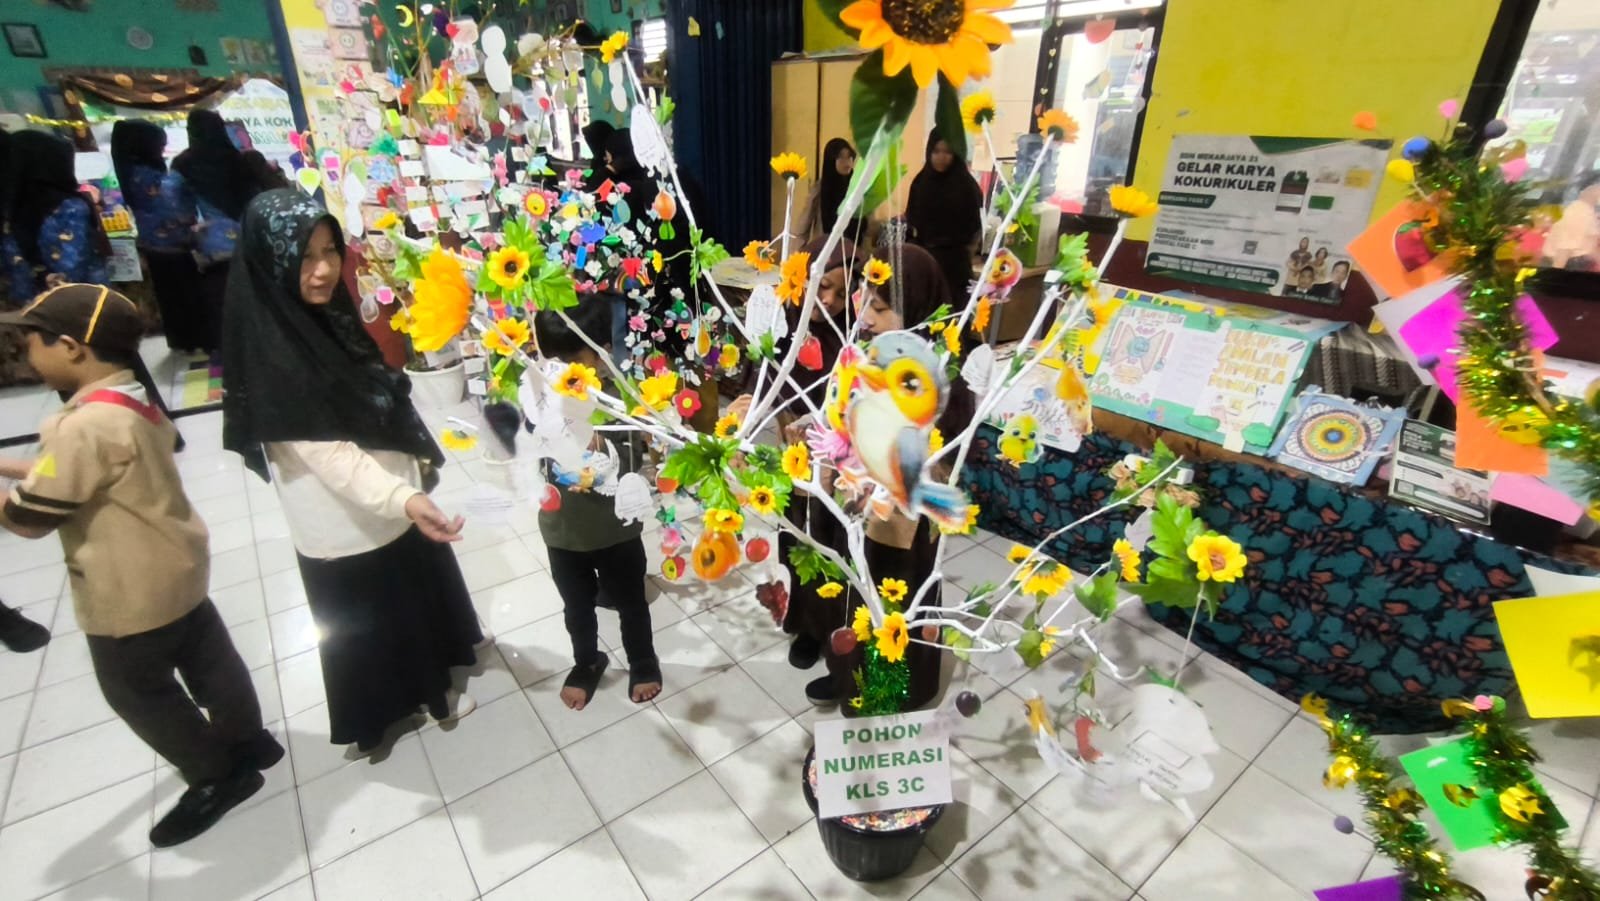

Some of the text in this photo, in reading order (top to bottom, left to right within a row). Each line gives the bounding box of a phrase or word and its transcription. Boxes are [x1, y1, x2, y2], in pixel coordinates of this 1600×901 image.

[1177, 162, 1275, 177] GELAR KARYA
[1174, 176, 1276, 192] KOKURIKULER
[842, 723, 921, 744] POHON
[824, 747, 943, 774] NUMERASI
[846, 777, 924, 800] KLS 3C
